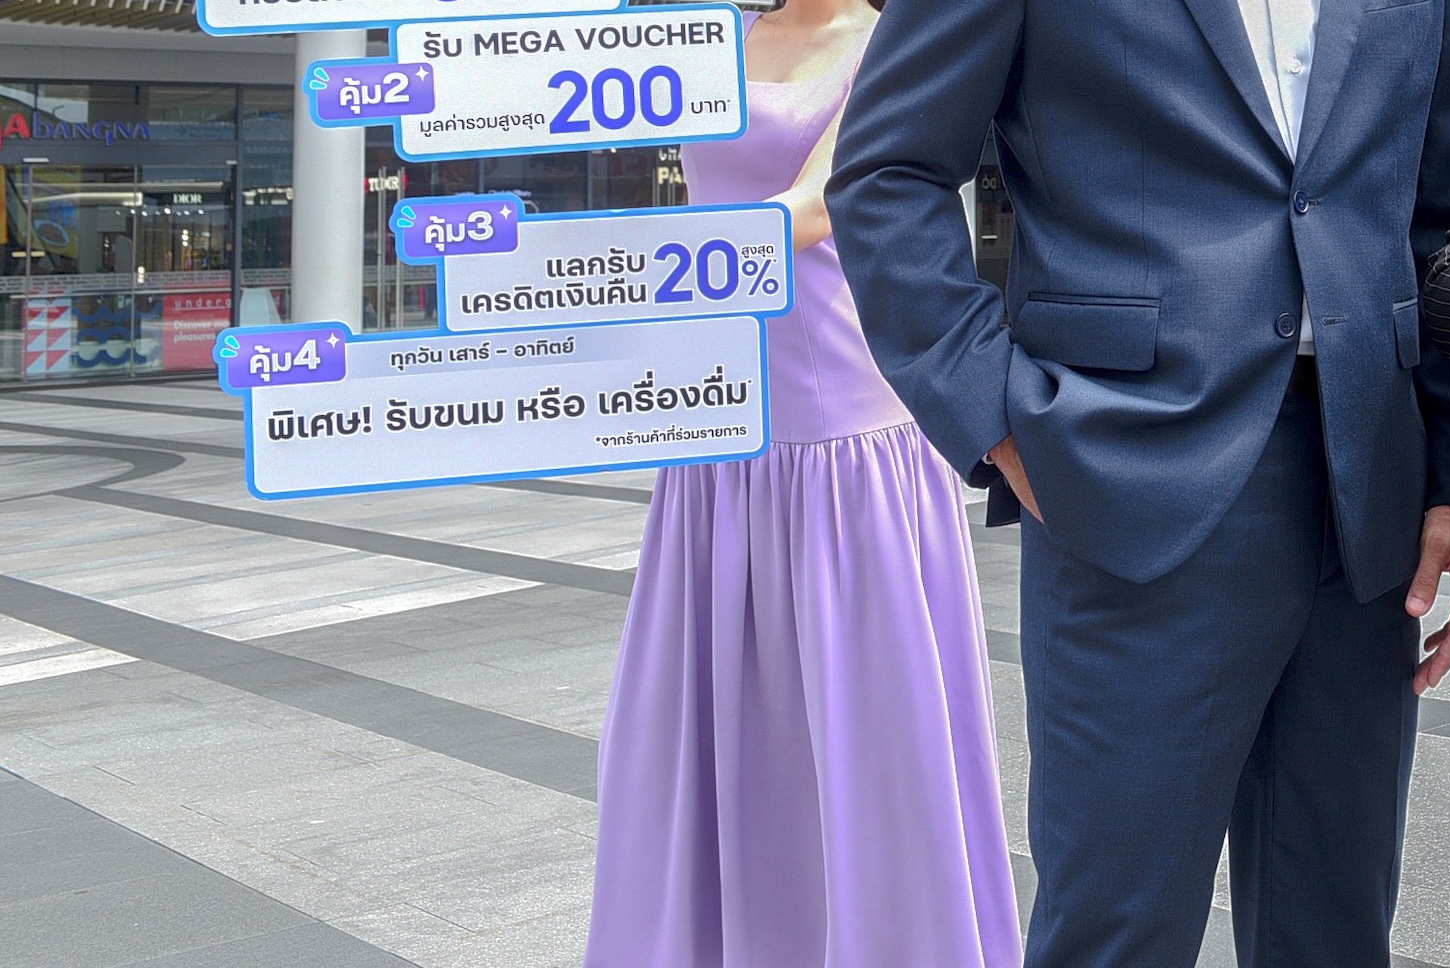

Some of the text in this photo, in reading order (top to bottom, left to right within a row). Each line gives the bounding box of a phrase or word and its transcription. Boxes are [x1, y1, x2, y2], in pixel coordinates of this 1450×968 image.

[423, 21, 725, 59] รับ MEGA VOUCHER
[339, 72, 410, 115] คุ้ม2
[419, 113, 545, 137] มูลค่ารวมสูงสุด
[547, 64, 683, 135] 200
[172, 193, 203, 205] DIOR
[424, 210, 495, 252] คุ้ม3
[546, 247, 646, 278] แลกรับ
[460, 278, 647, 314] เครดิตเงินคืน
[249, 339, 321, 382] คุ้ม4
[390, 347, 443, 371] ทุกวัน
[449, 342, 491, 364] เสาร์
[513, 336, 575, 358] อาทิตย์
[267, 365, 748, 441] พิเศษ! รับขนม หรือ เครื่องดื่ม
